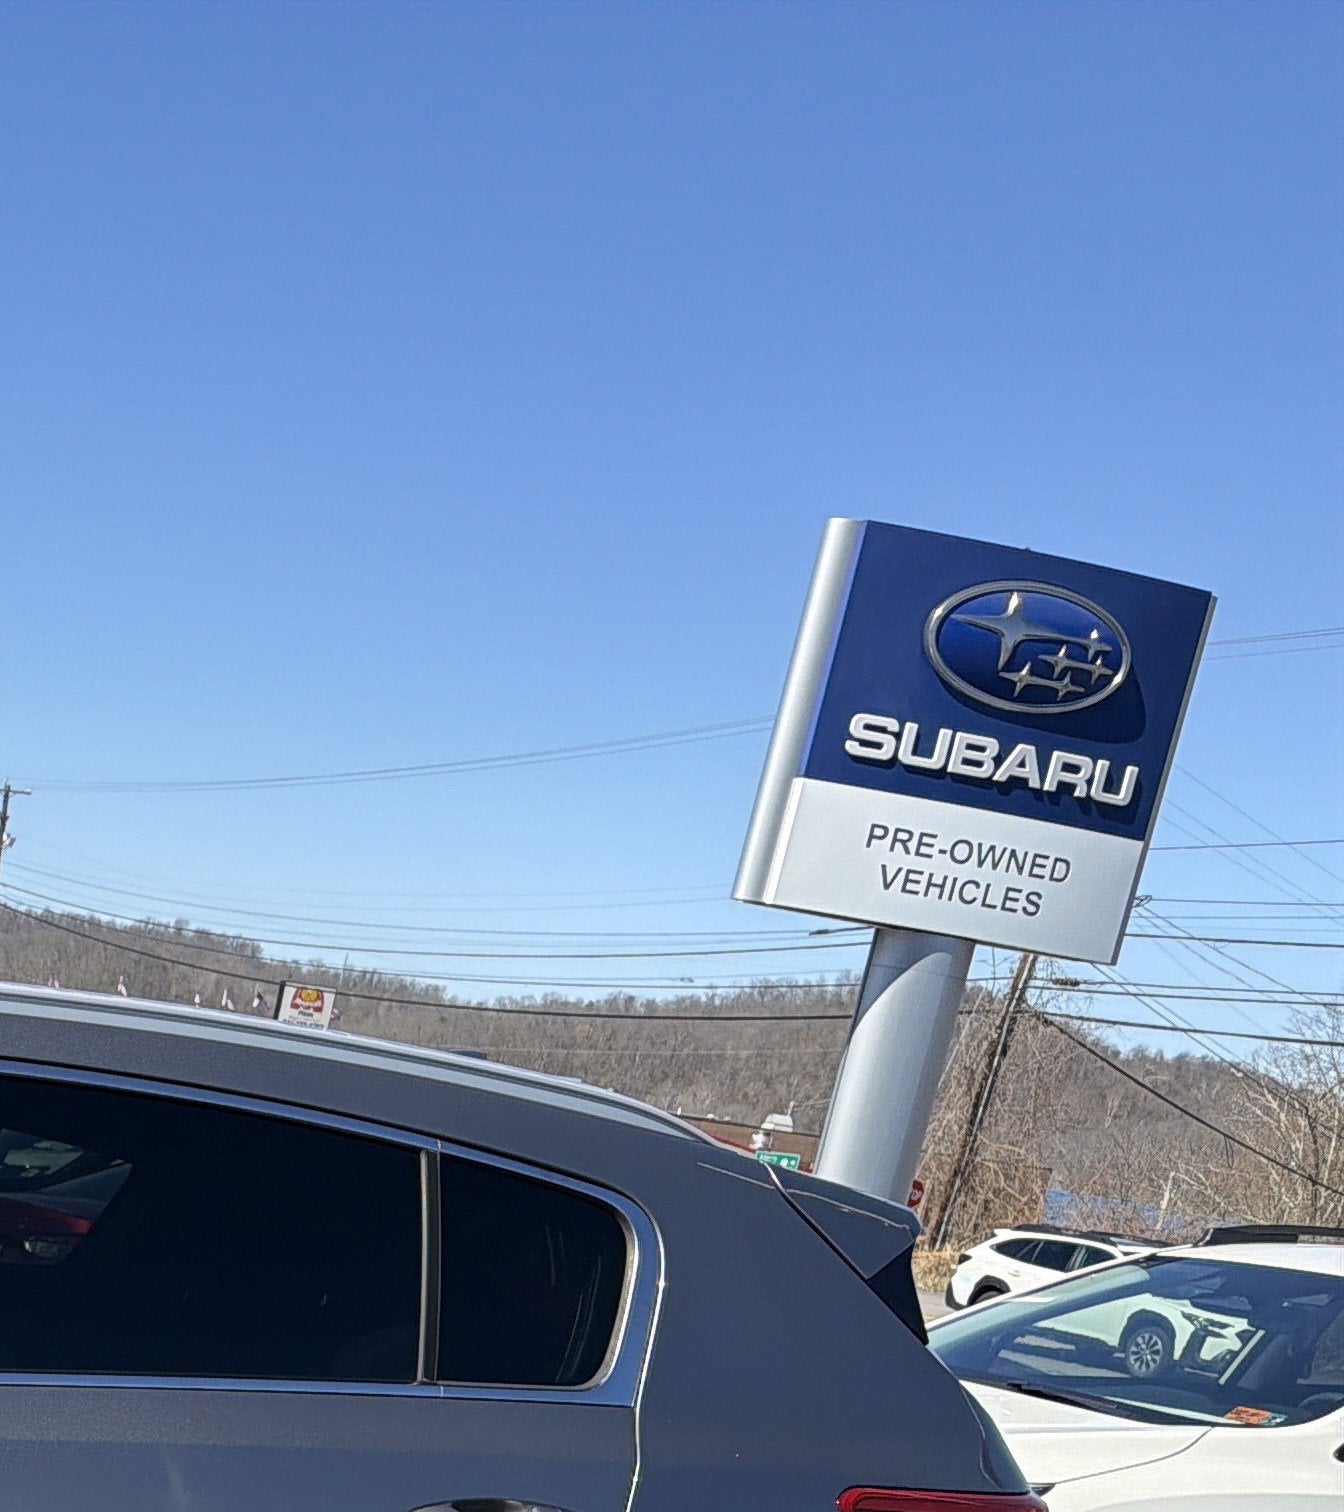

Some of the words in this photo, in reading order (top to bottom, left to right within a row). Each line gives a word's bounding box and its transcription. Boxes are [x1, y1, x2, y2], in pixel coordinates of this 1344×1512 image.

[844, 712, 1140, 807] SUBARU
[864, 823, 1071, 884] PRE-OWNED
[880, 863, 1044, 917] VEHICLES
